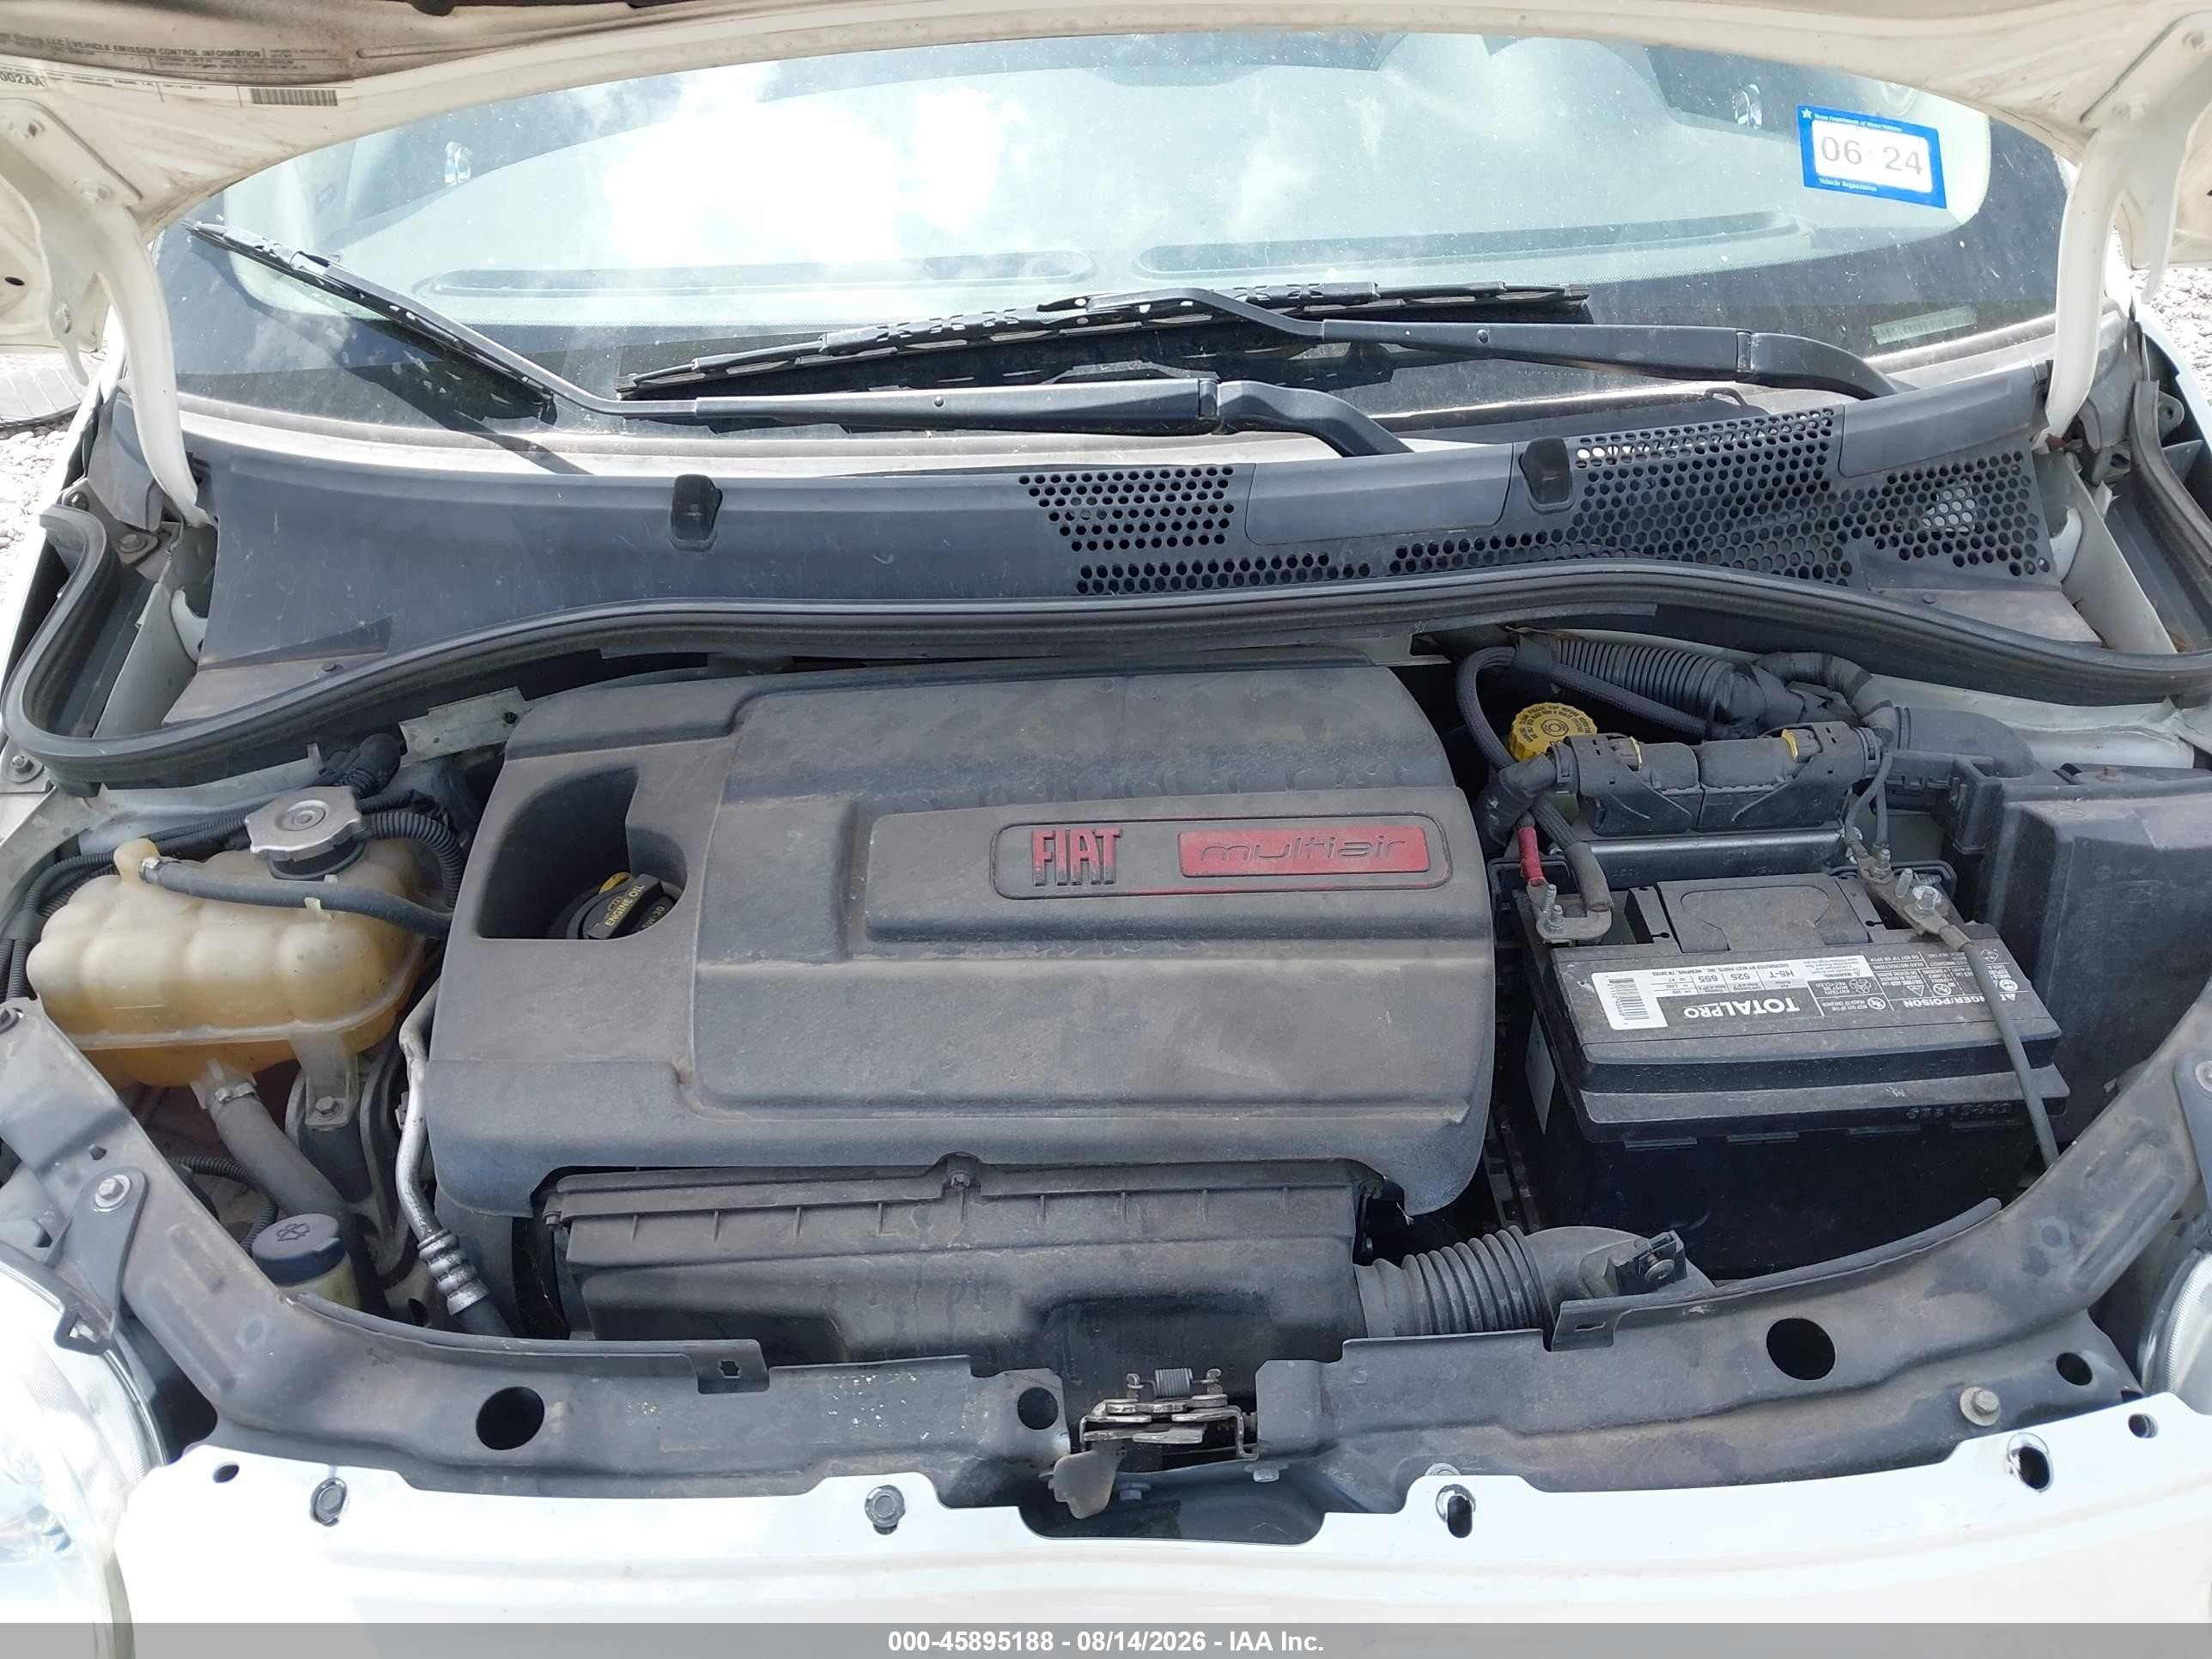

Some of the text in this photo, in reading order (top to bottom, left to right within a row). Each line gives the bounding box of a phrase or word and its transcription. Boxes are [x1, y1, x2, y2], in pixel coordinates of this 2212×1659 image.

[73, 41, 111, 52] VEHICLE
[114, 45, 156, 55] EMISSION
[159, 47, 198, 57] CONTROL
[202, 49, 261, 58] INFORMATION
[1820, 137, 1923, 175] 06 24
[1818, 177, 1878, 191] Vehicle Registration
[1032, 828, 1123, 886] FIAT
[1200, 834, 1409, 861] multiair
[605, 884, 646, 927] ENGINE OIL
[1698, 974, 1718, 982] 655
[1730, 972, 1751, 981] 525
[1769, 969, 1795, 979] H5-T
[1682, 997, 1801, 1019] TOTALPRO
